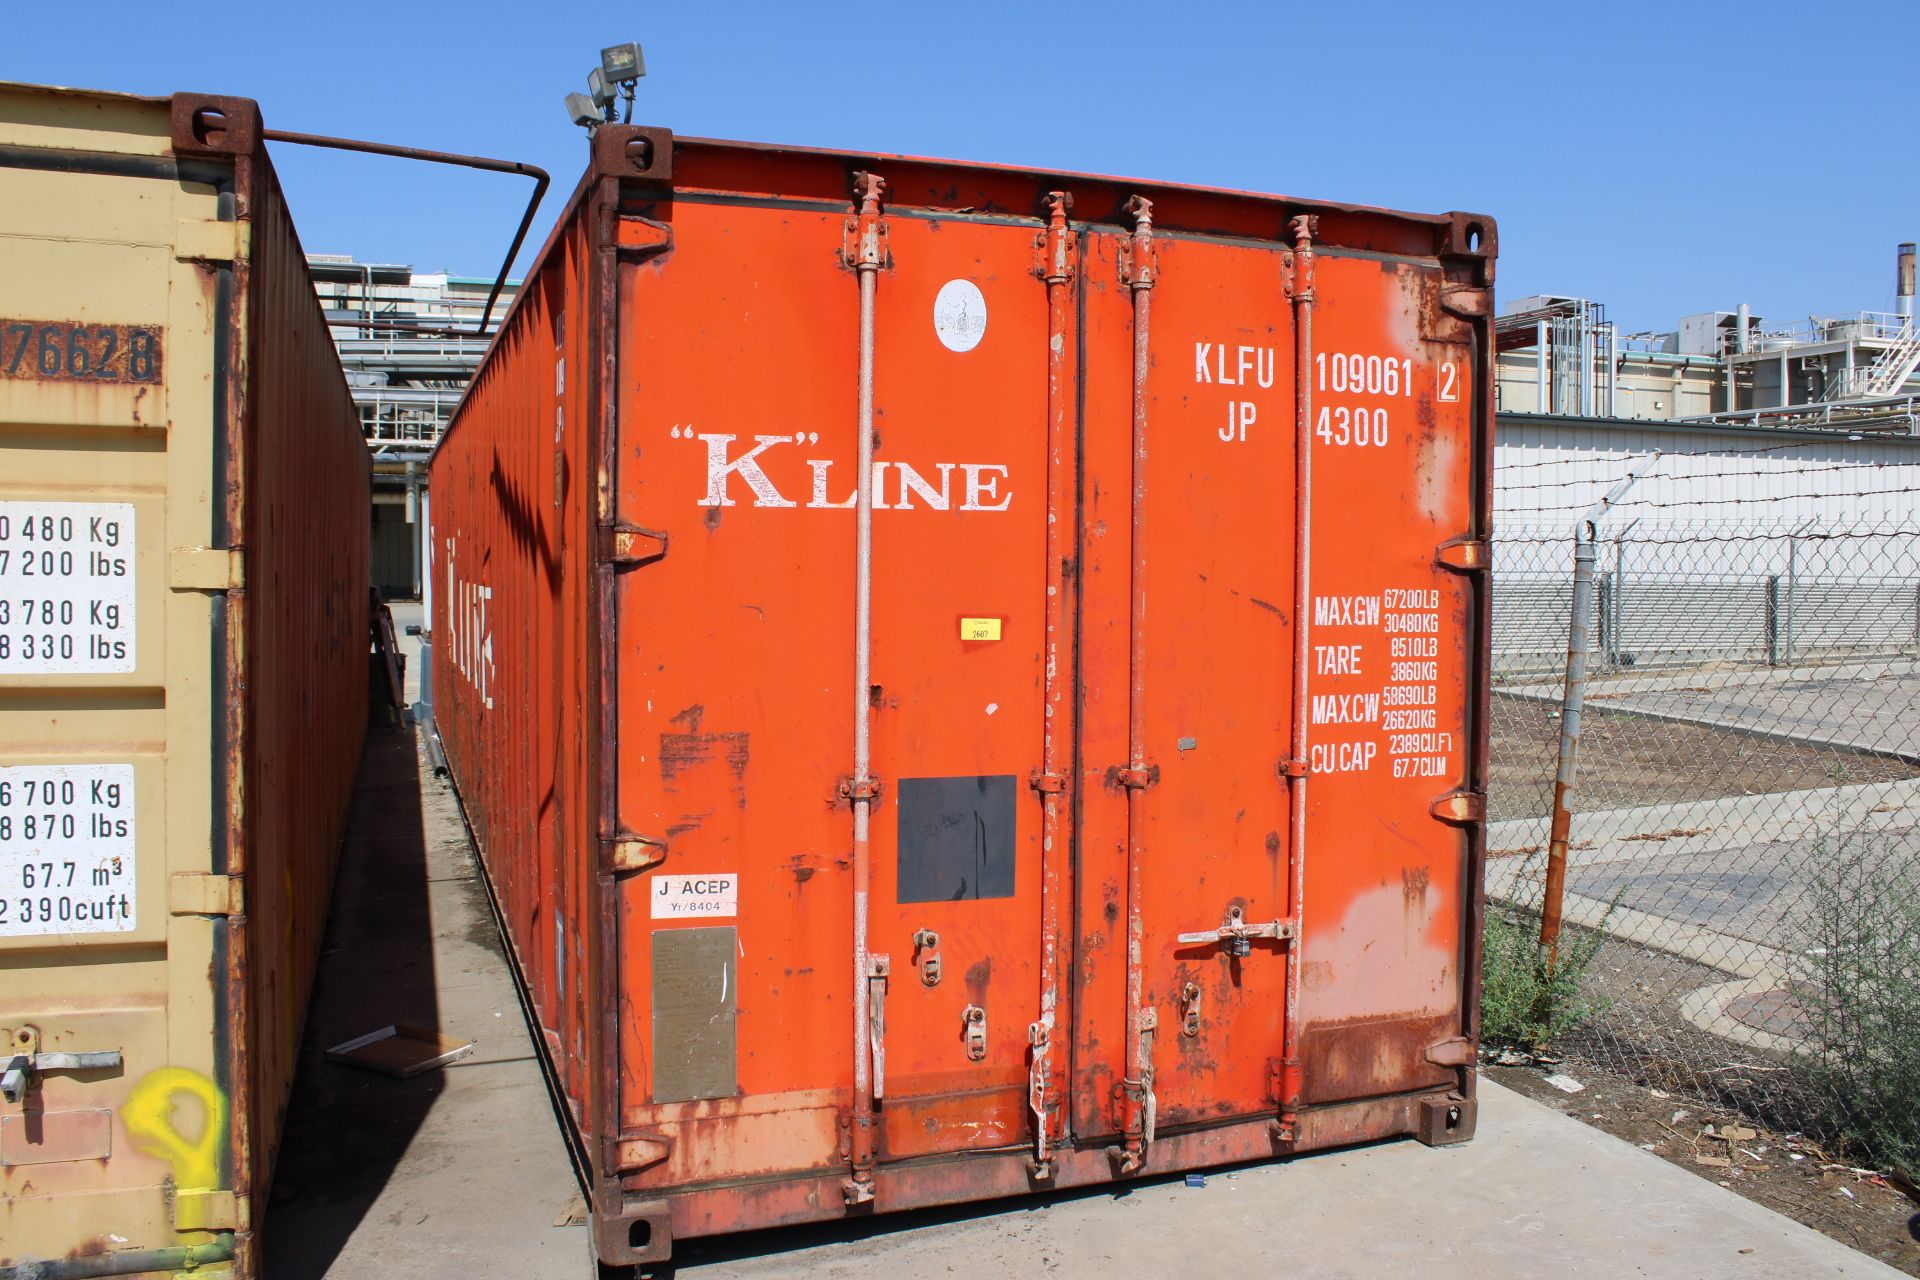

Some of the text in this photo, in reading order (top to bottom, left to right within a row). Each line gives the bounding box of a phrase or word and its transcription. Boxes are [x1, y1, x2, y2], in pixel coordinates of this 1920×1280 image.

[1195, 342, 1456, 400] KLFU 109061 2
[1218, 400, 1388, 447] JP 4300
[90, 516, 119, 547] Kg
[90, 551, 126, 576] lbs
[90, 599, 119, 630] Kg
[90, 634, 126, 660] lbs
[1314, 645, 1362, 675] TARE
[91, 779, 121, 808] Kg
[91, 813, 128, 838] lbs
[22, 861, 76, 889] 67.7
[659, 880, 730, 896] J ACEP
